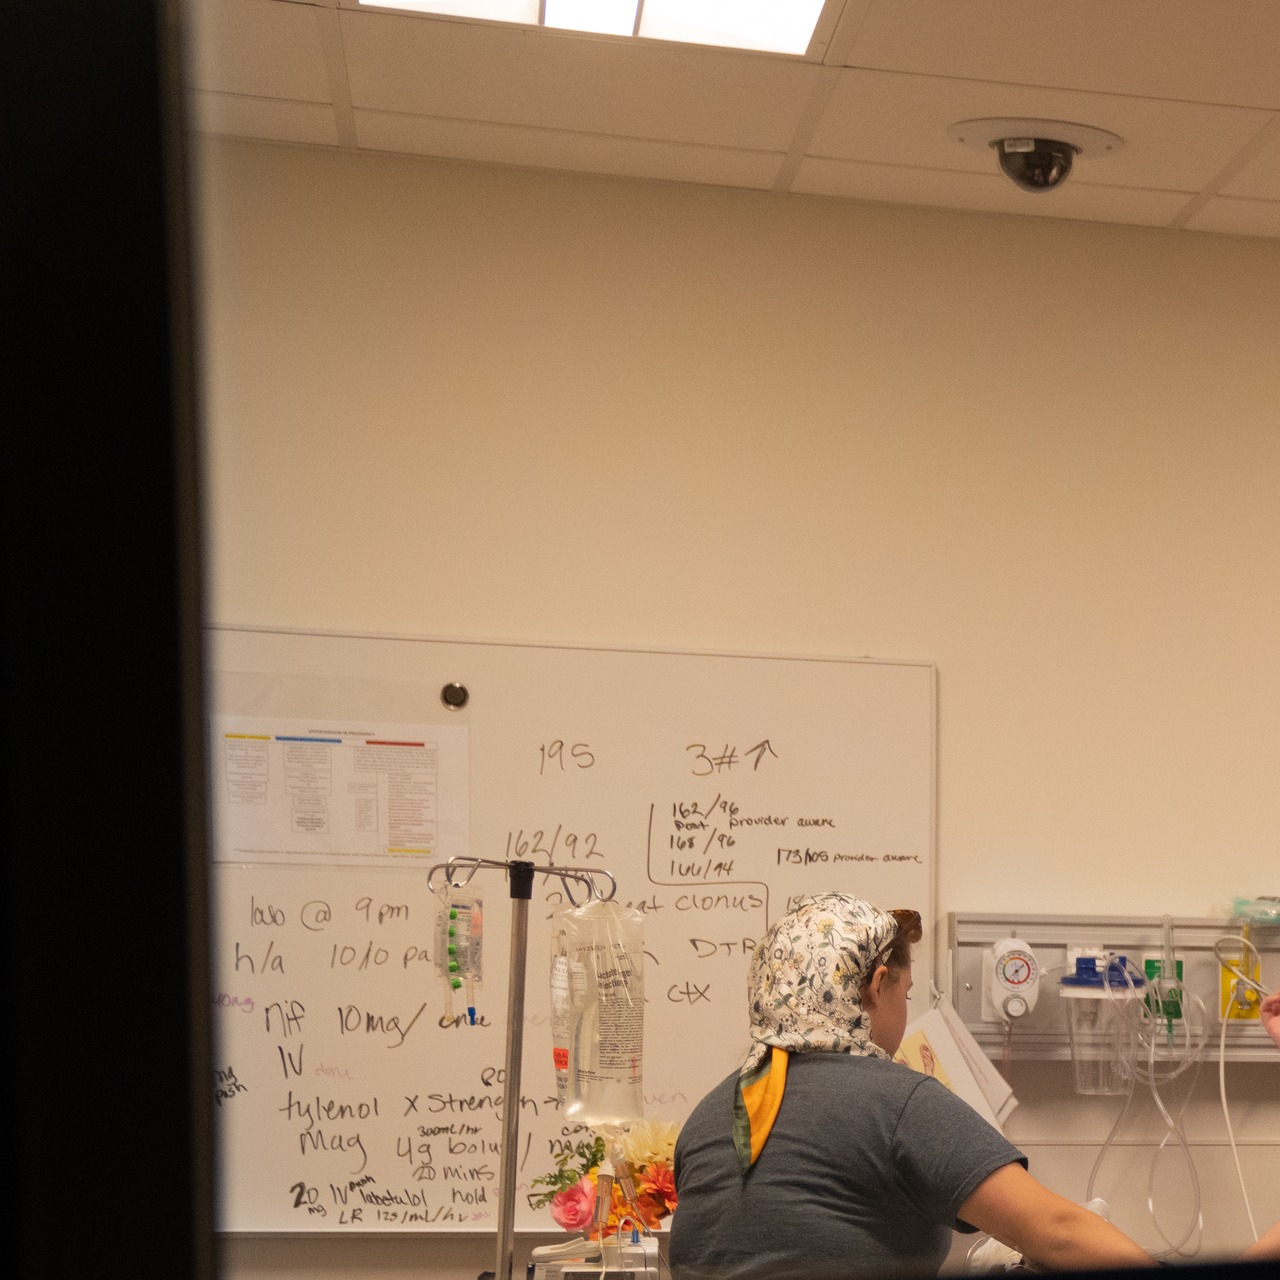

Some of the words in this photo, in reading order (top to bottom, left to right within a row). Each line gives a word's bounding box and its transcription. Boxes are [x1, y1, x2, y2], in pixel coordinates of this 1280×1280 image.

[540, 739, 595, 775] 195
[673, 793, 740, 819] 162/96
[729, 815, 789, 829] provider
[506, 824, 605, 866] 162/92
[251, 895, 285, 927] lab
[675, 894, 764, 912] clonus
[235, 940, 284, 975] h/a
[279, 1091, 380, 1131] tylenol
[448, 1137, 503, 1157] bolu
[443, 1164, 495, 1182] mins
[338, 1208, 363, 1225] LR
